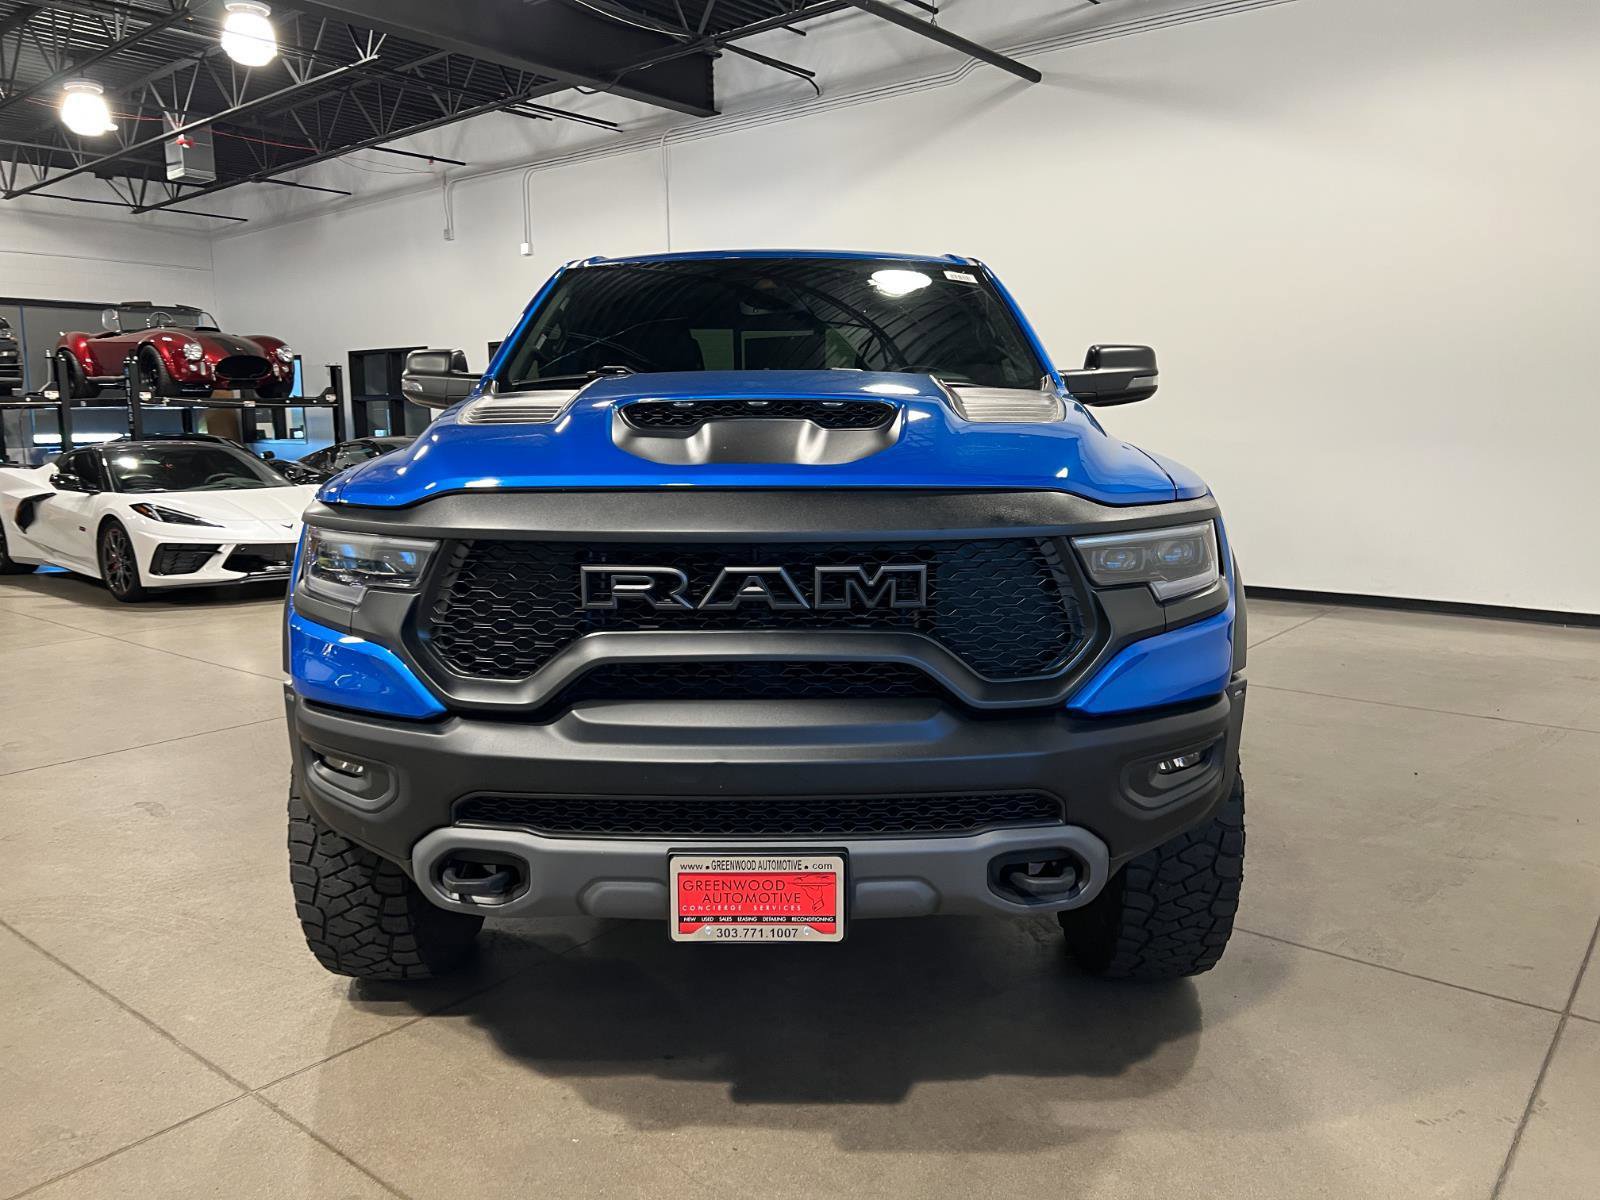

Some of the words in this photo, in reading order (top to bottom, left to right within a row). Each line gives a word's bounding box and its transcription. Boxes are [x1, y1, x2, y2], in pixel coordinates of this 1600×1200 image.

[580, 566, 927, 609] RAM
[711, 860, 757, 871] GREENWOOD
[757, 860, 802, 871] AUTOMOTIVE
[812, 862, 833, 870] com
[682, 879, 786, 891] GREENWOOD
[702, 892, 801, 904] AUTOMOTIVE
[716, 928, 799, 938] 303.771.1007
